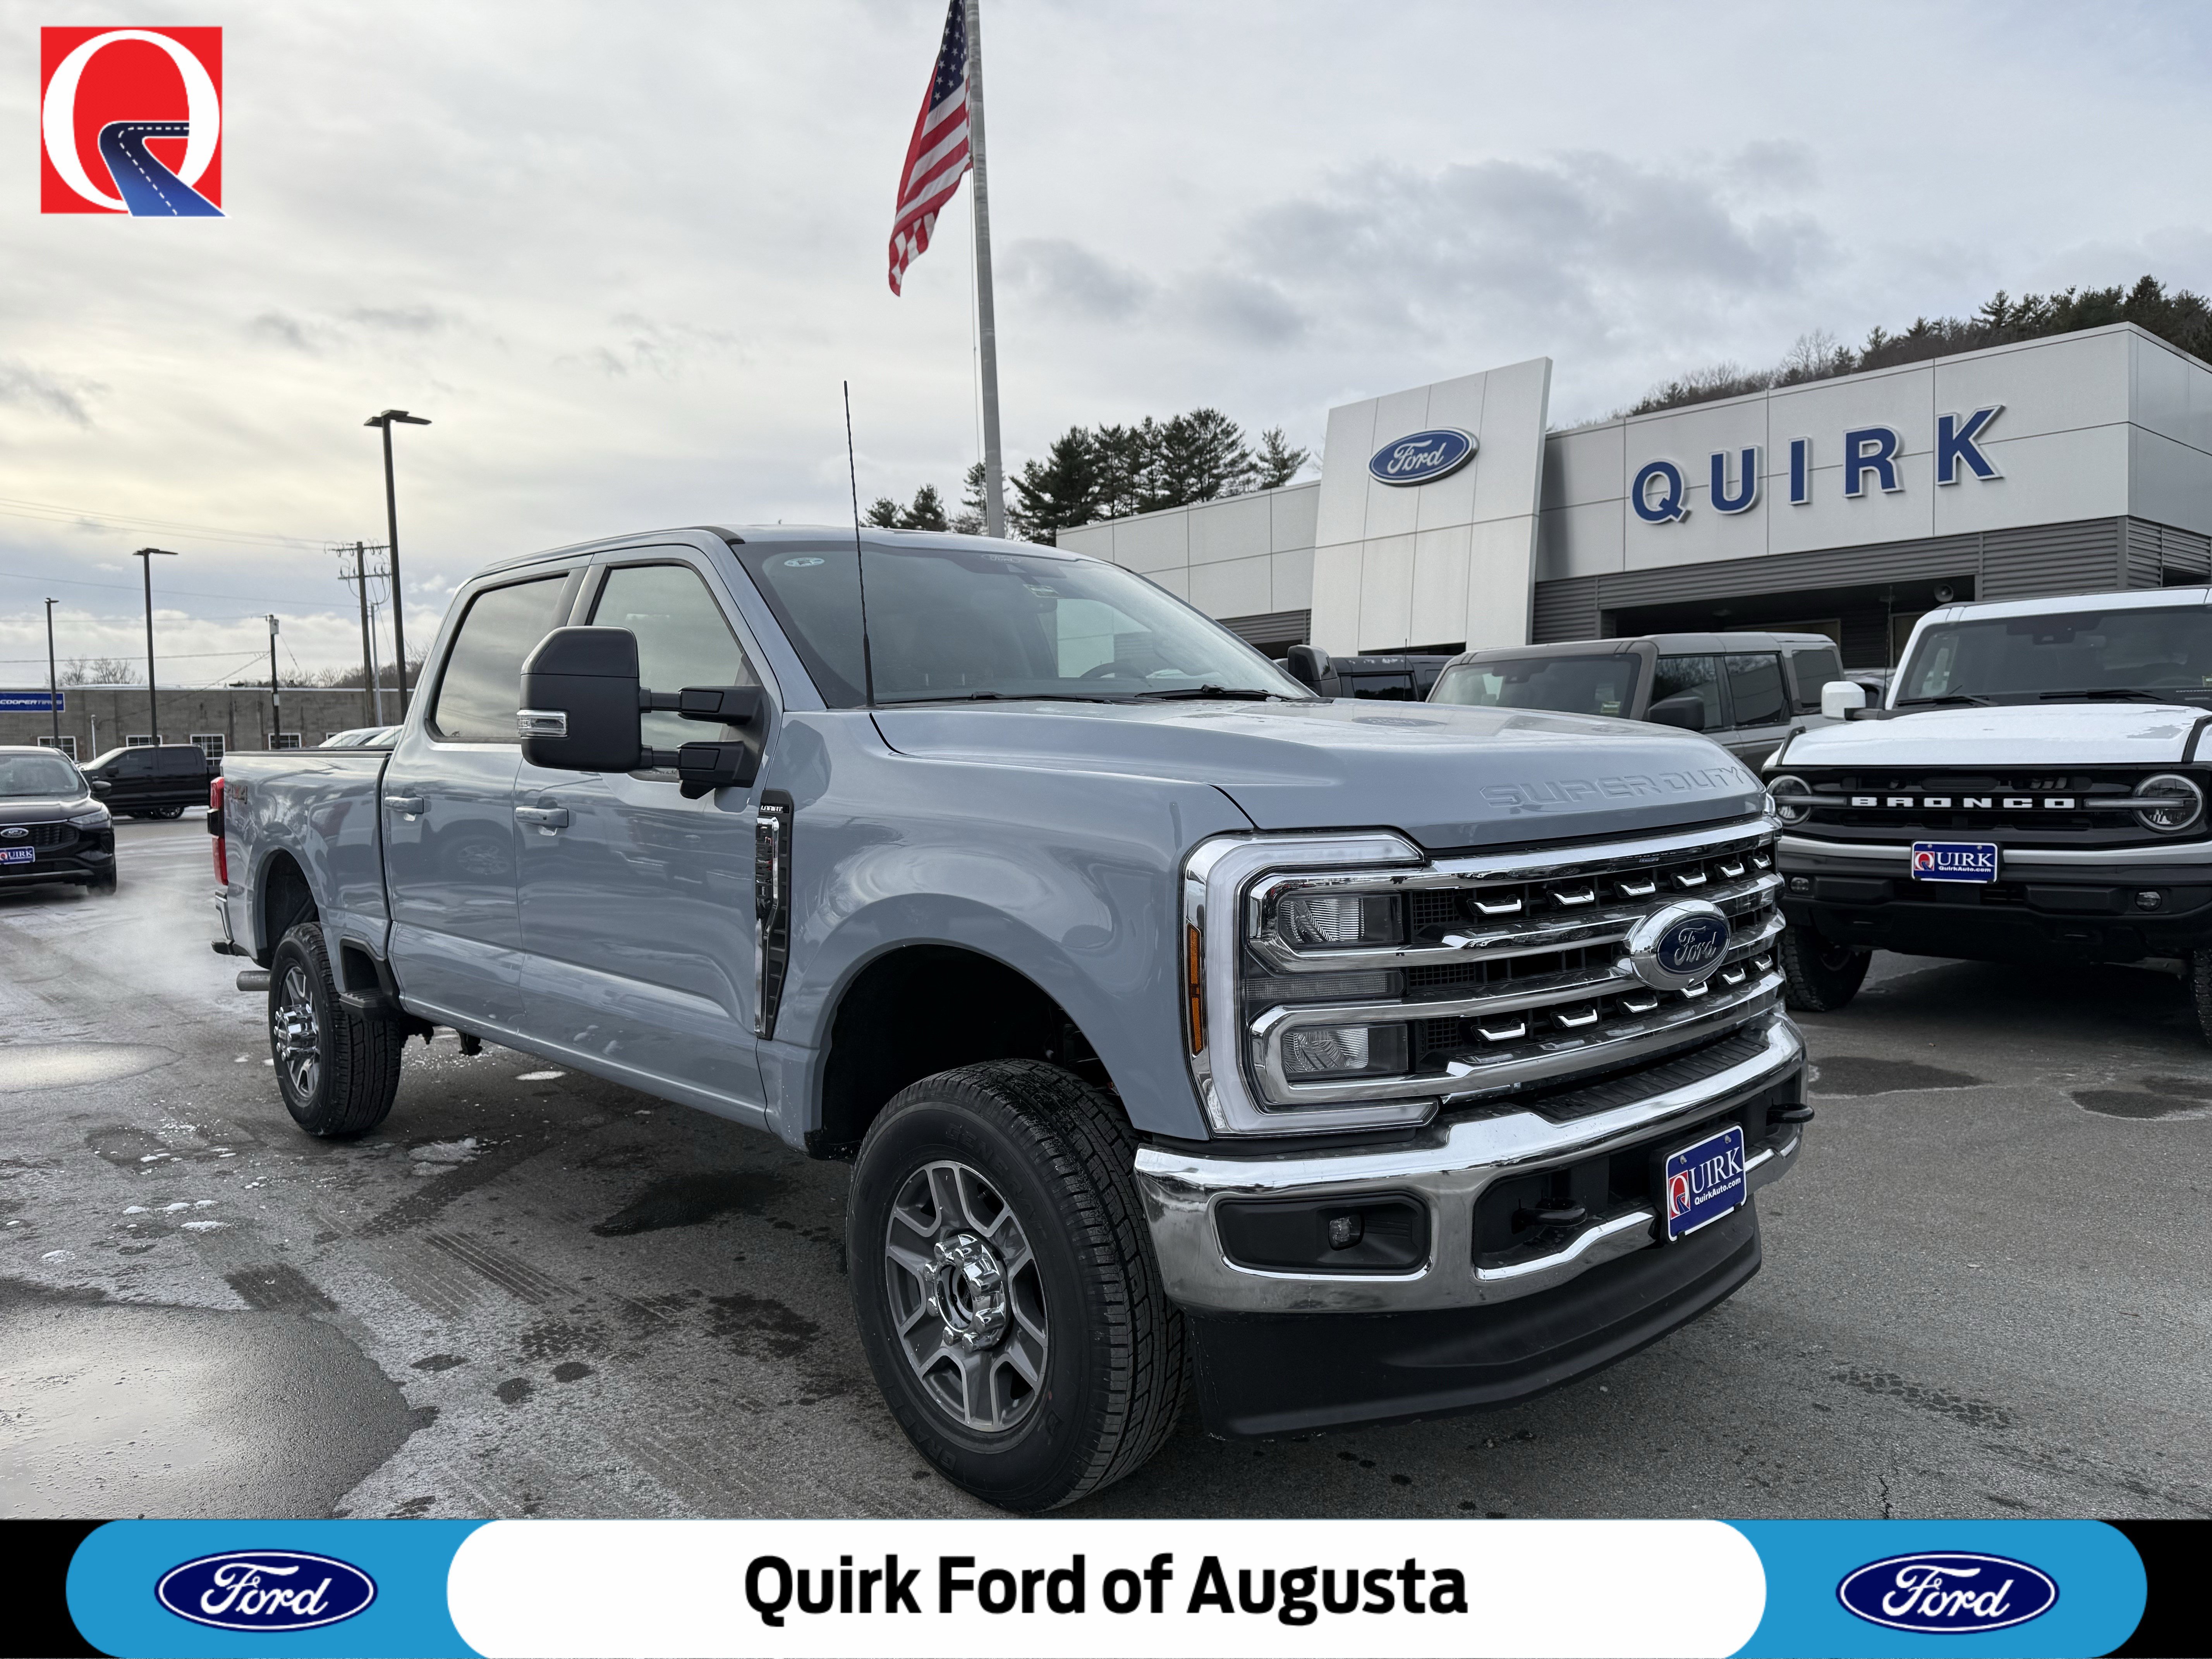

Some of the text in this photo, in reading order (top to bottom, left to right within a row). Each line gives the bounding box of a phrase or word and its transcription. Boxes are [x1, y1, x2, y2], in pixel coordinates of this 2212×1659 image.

[1387, 439, 1447, 474] Ford
[1632, 404, 2005, 524] QUIRK
[1479, 766, 1746, 808] SUPER DUTY
[1851, 796, 2076, 809] BRONCO
[1915, 852, 1994, 871] QUIRK
[1674, 926, 1717, 966] Ford
[1670, 1146, 1743, 1215] QUIRK
[1694, 1177, 1741, 1206] QuirkAuto.com
